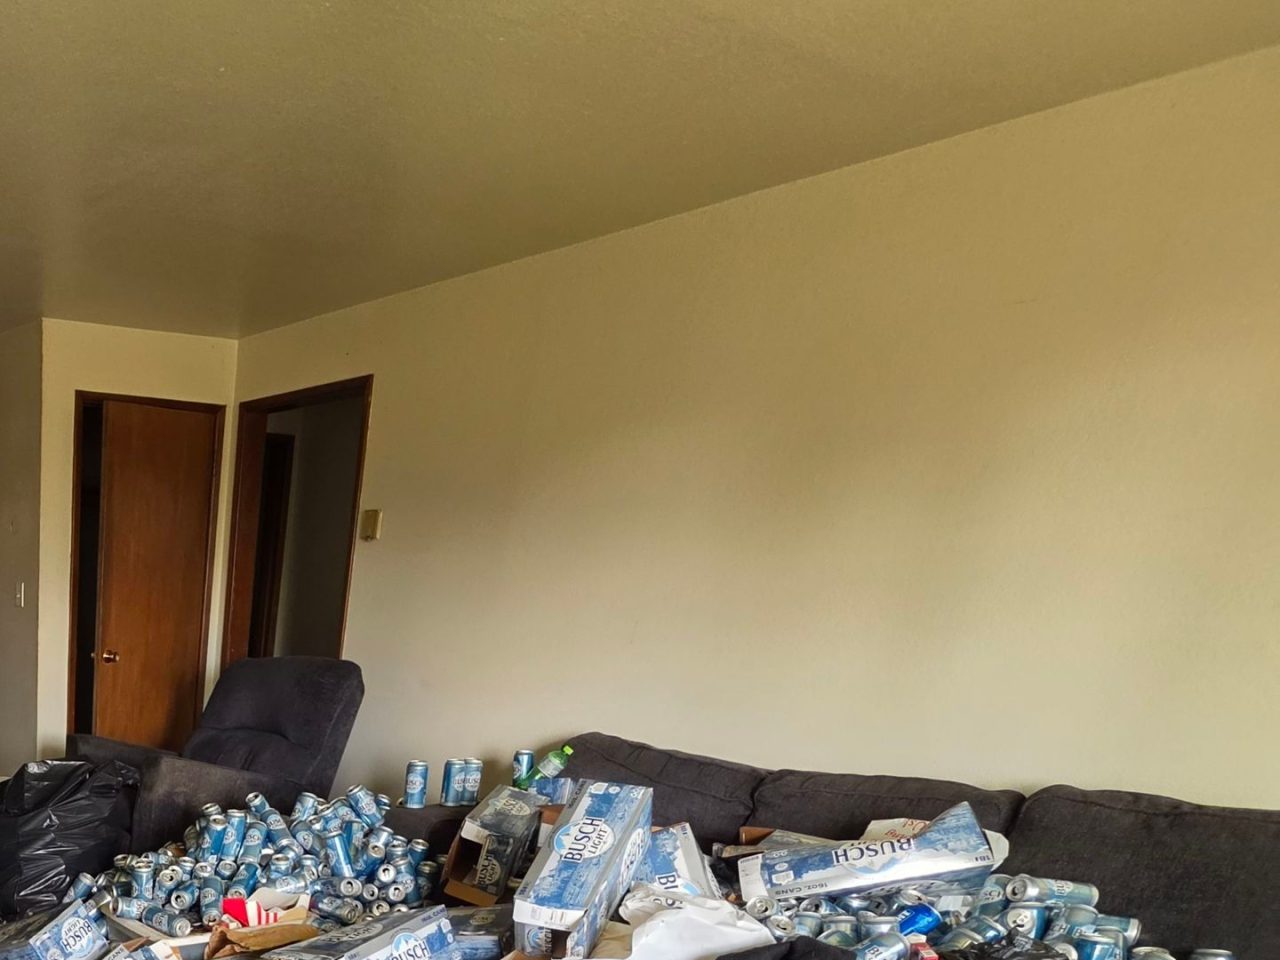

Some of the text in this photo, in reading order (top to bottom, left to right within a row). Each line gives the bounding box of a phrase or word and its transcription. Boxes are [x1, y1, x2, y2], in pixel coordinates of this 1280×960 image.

[562, 816, 604, 863] BUSCH
[587, 828, 609, 855] LIGHT
[833, 837, 914, 864] BUSCH
[61, 918, 93, 952] BUSCH
[63, 916, 83, 938] LIGHT
